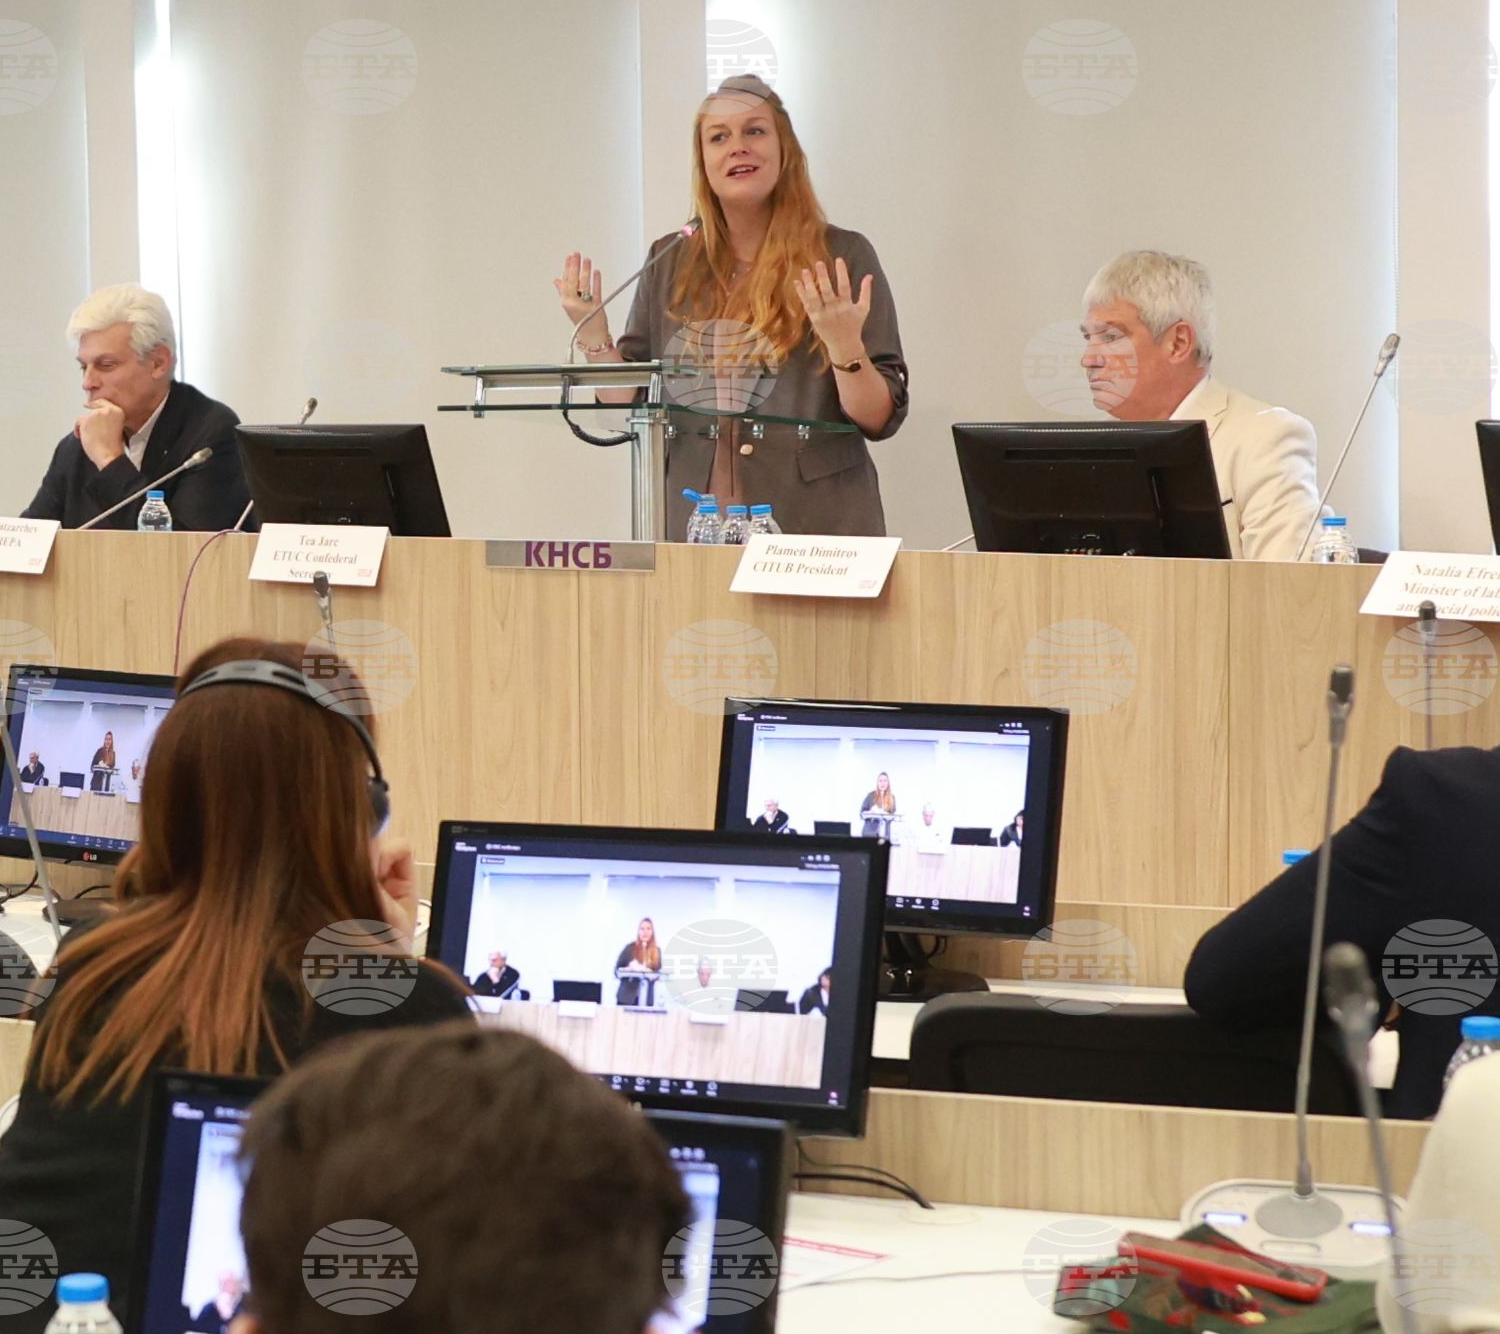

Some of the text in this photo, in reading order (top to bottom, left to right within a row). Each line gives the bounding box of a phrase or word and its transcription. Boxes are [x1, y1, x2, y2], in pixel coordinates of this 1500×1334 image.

[299, 534, 315, 547] Tea
[273, 550, 358, 565] ETUC Confederal
[525, 540, 613, 569] КНСБ
[765, 544, 859, 559] Plamen Dimitrov
[795, 563, 849, 576] President
[1411, 564, 1462, 579] Natalia
[1400, 581, 1460, 597] Minister
[1463, 585, 1480, 598] of
